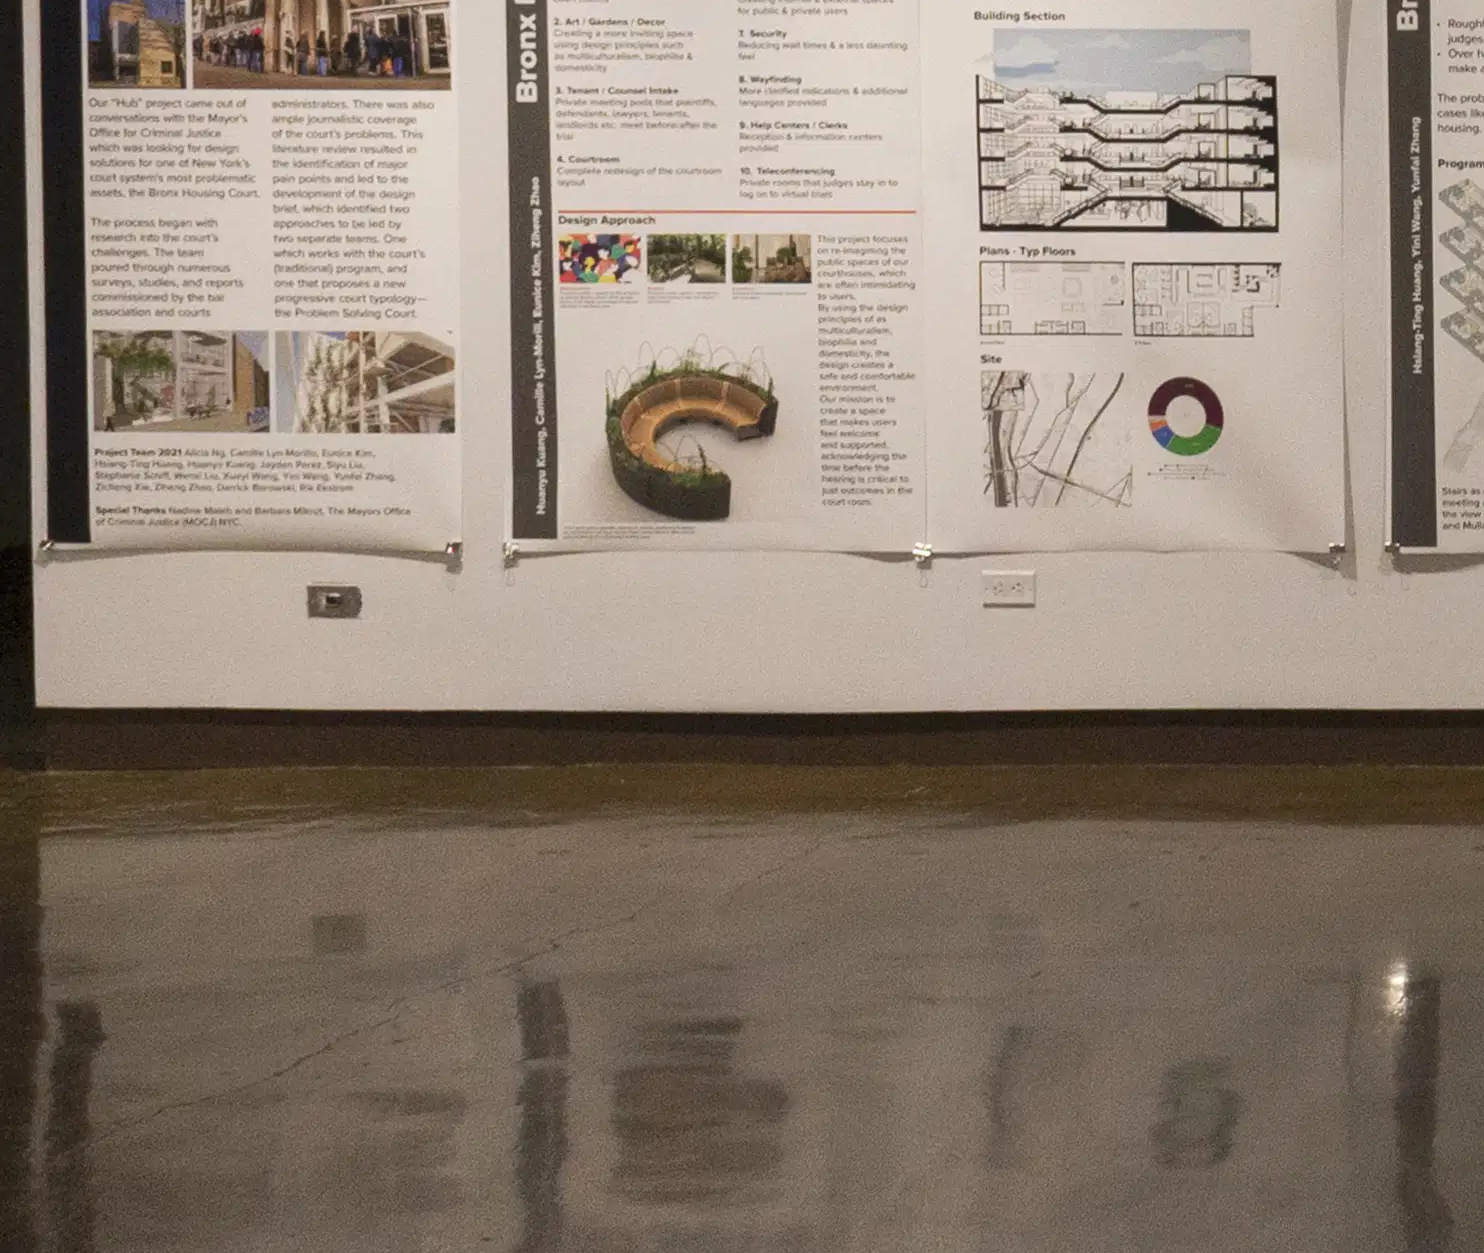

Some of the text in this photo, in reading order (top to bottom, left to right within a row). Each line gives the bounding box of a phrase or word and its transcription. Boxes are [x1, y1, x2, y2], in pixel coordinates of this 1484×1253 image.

[974, 11, 1065, 22] Building Section
[516, 14, 537, 102] Bronx
[558, 216, 655, 226] Design Approach
[980, 246, 1009, 255] Plans
[1020, 246, 1041, 257] Typ
[1042, 247, 1076, 256] Floors
[981, 355, 1002, 363] Site
